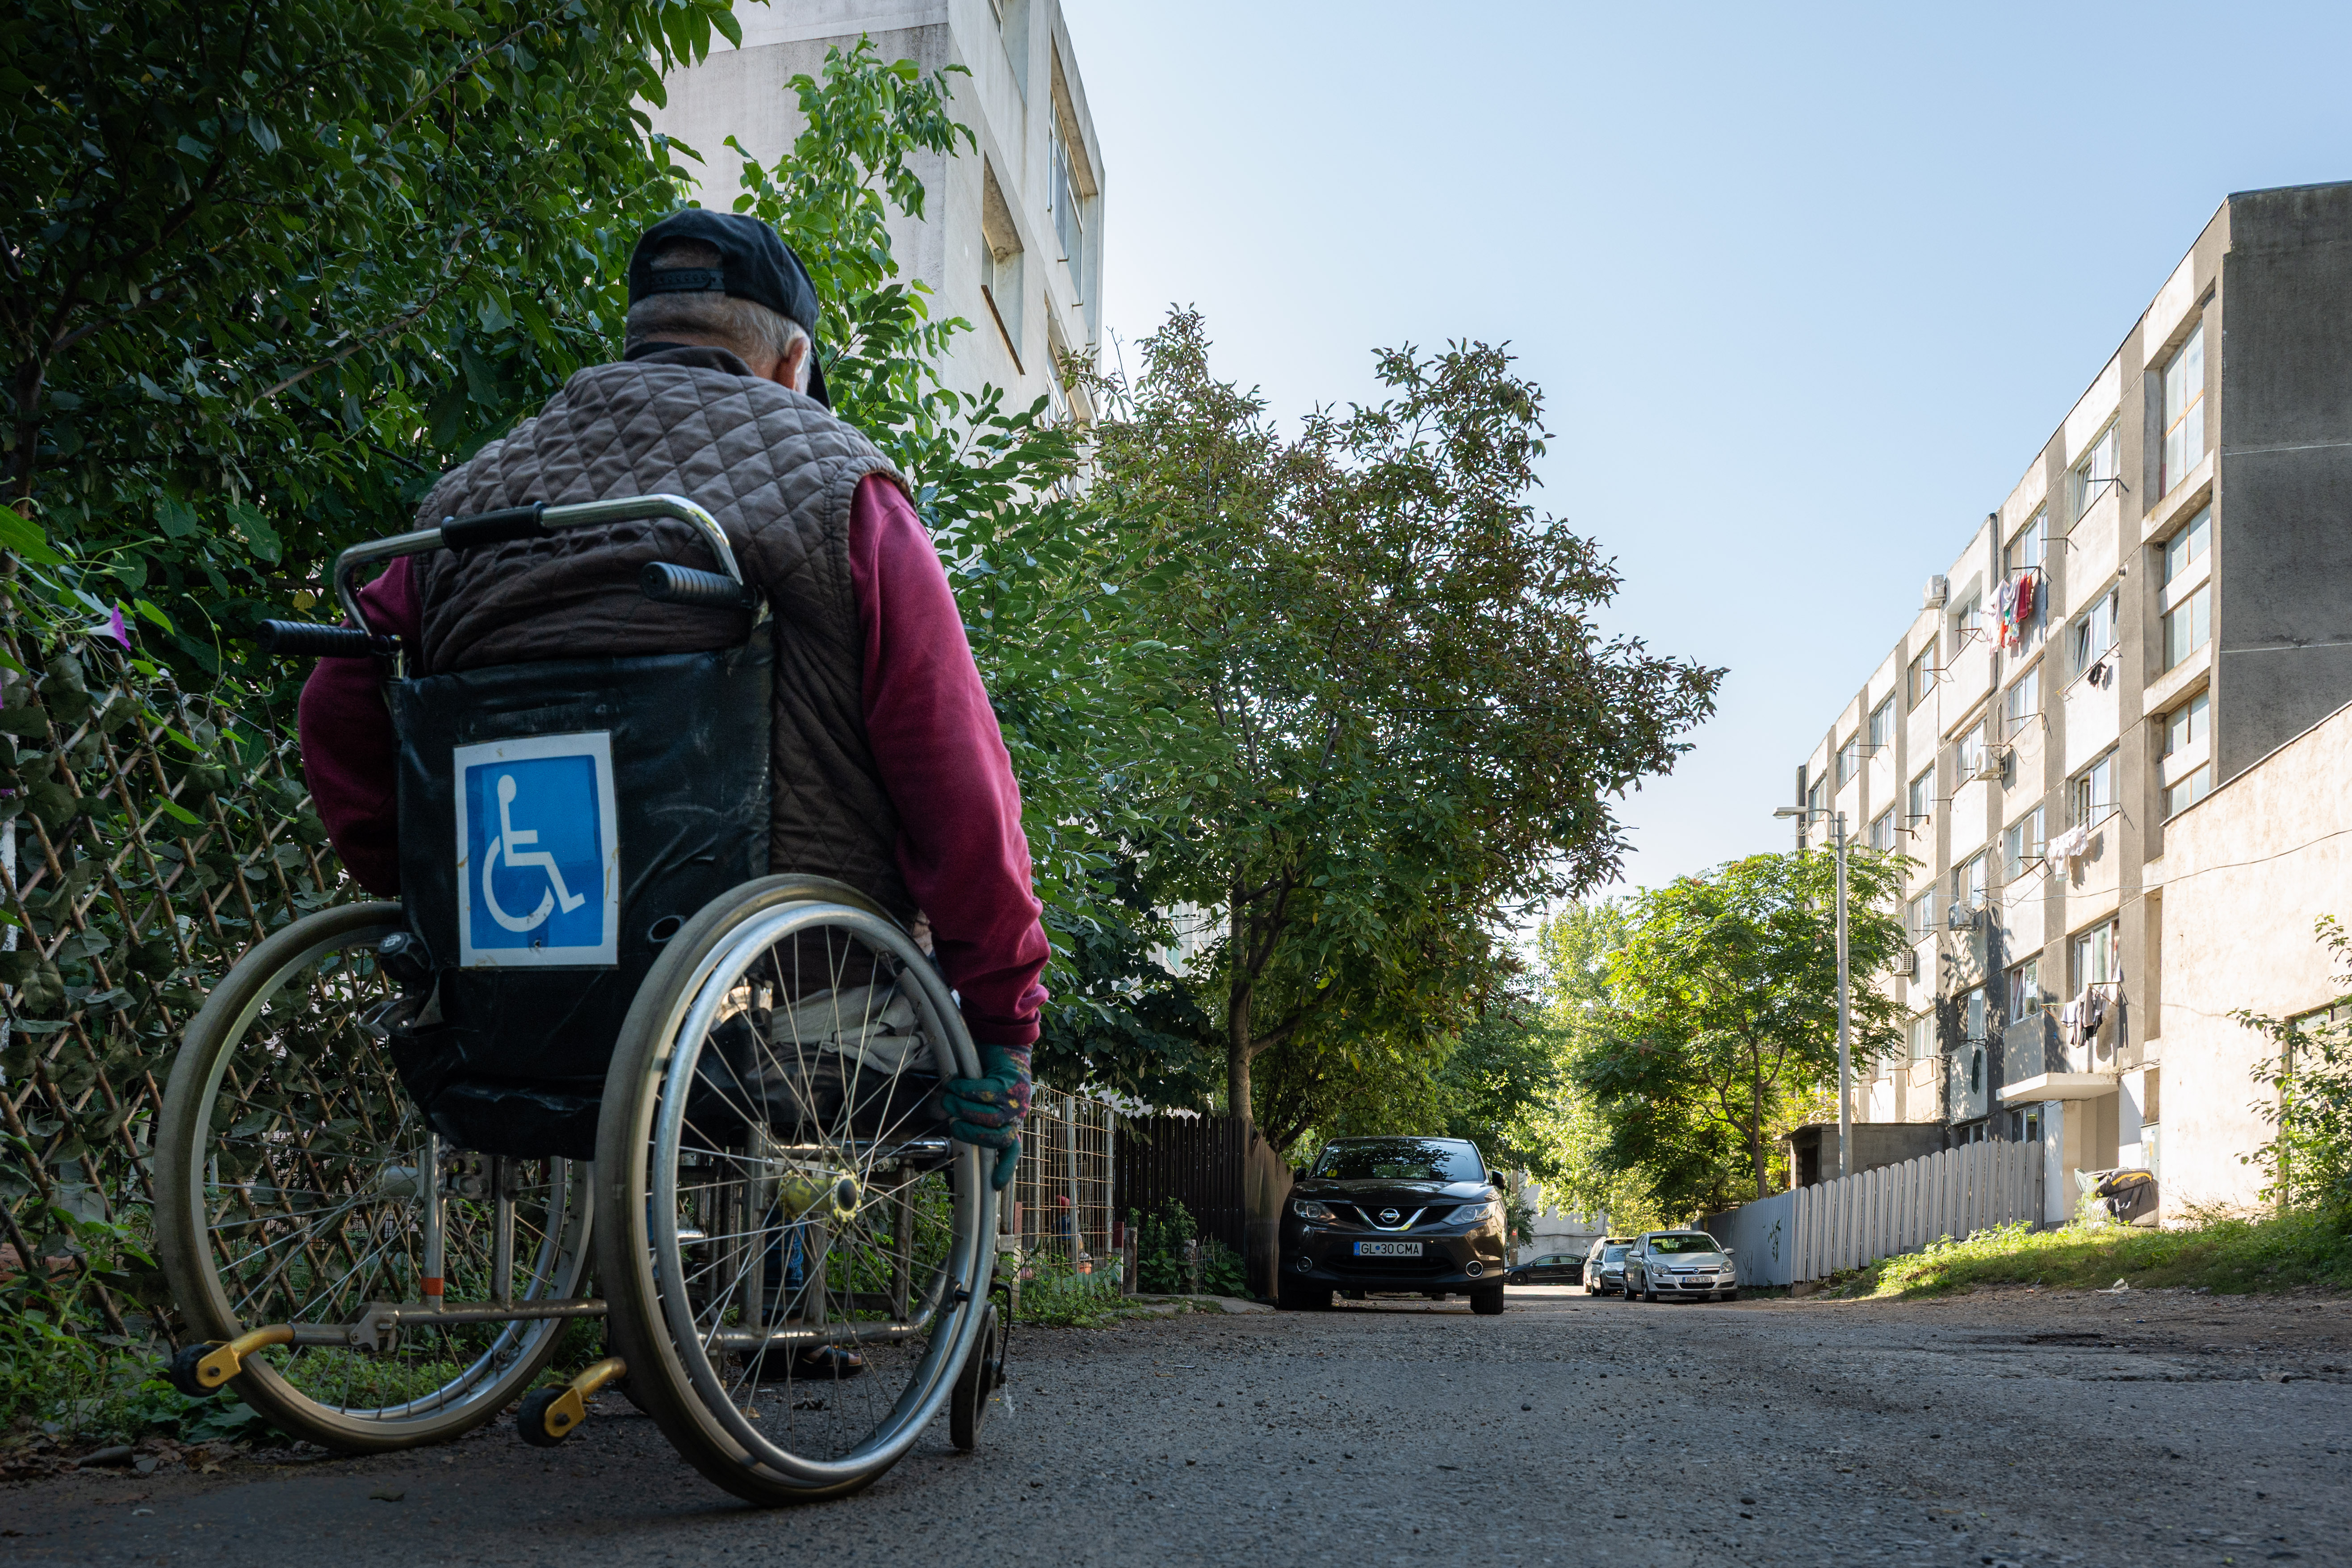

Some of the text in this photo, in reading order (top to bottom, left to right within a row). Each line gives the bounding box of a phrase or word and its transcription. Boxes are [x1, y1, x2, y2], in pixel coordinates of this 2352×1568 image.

[1361, 1243, 1419, 1254] GL 30 CMA
